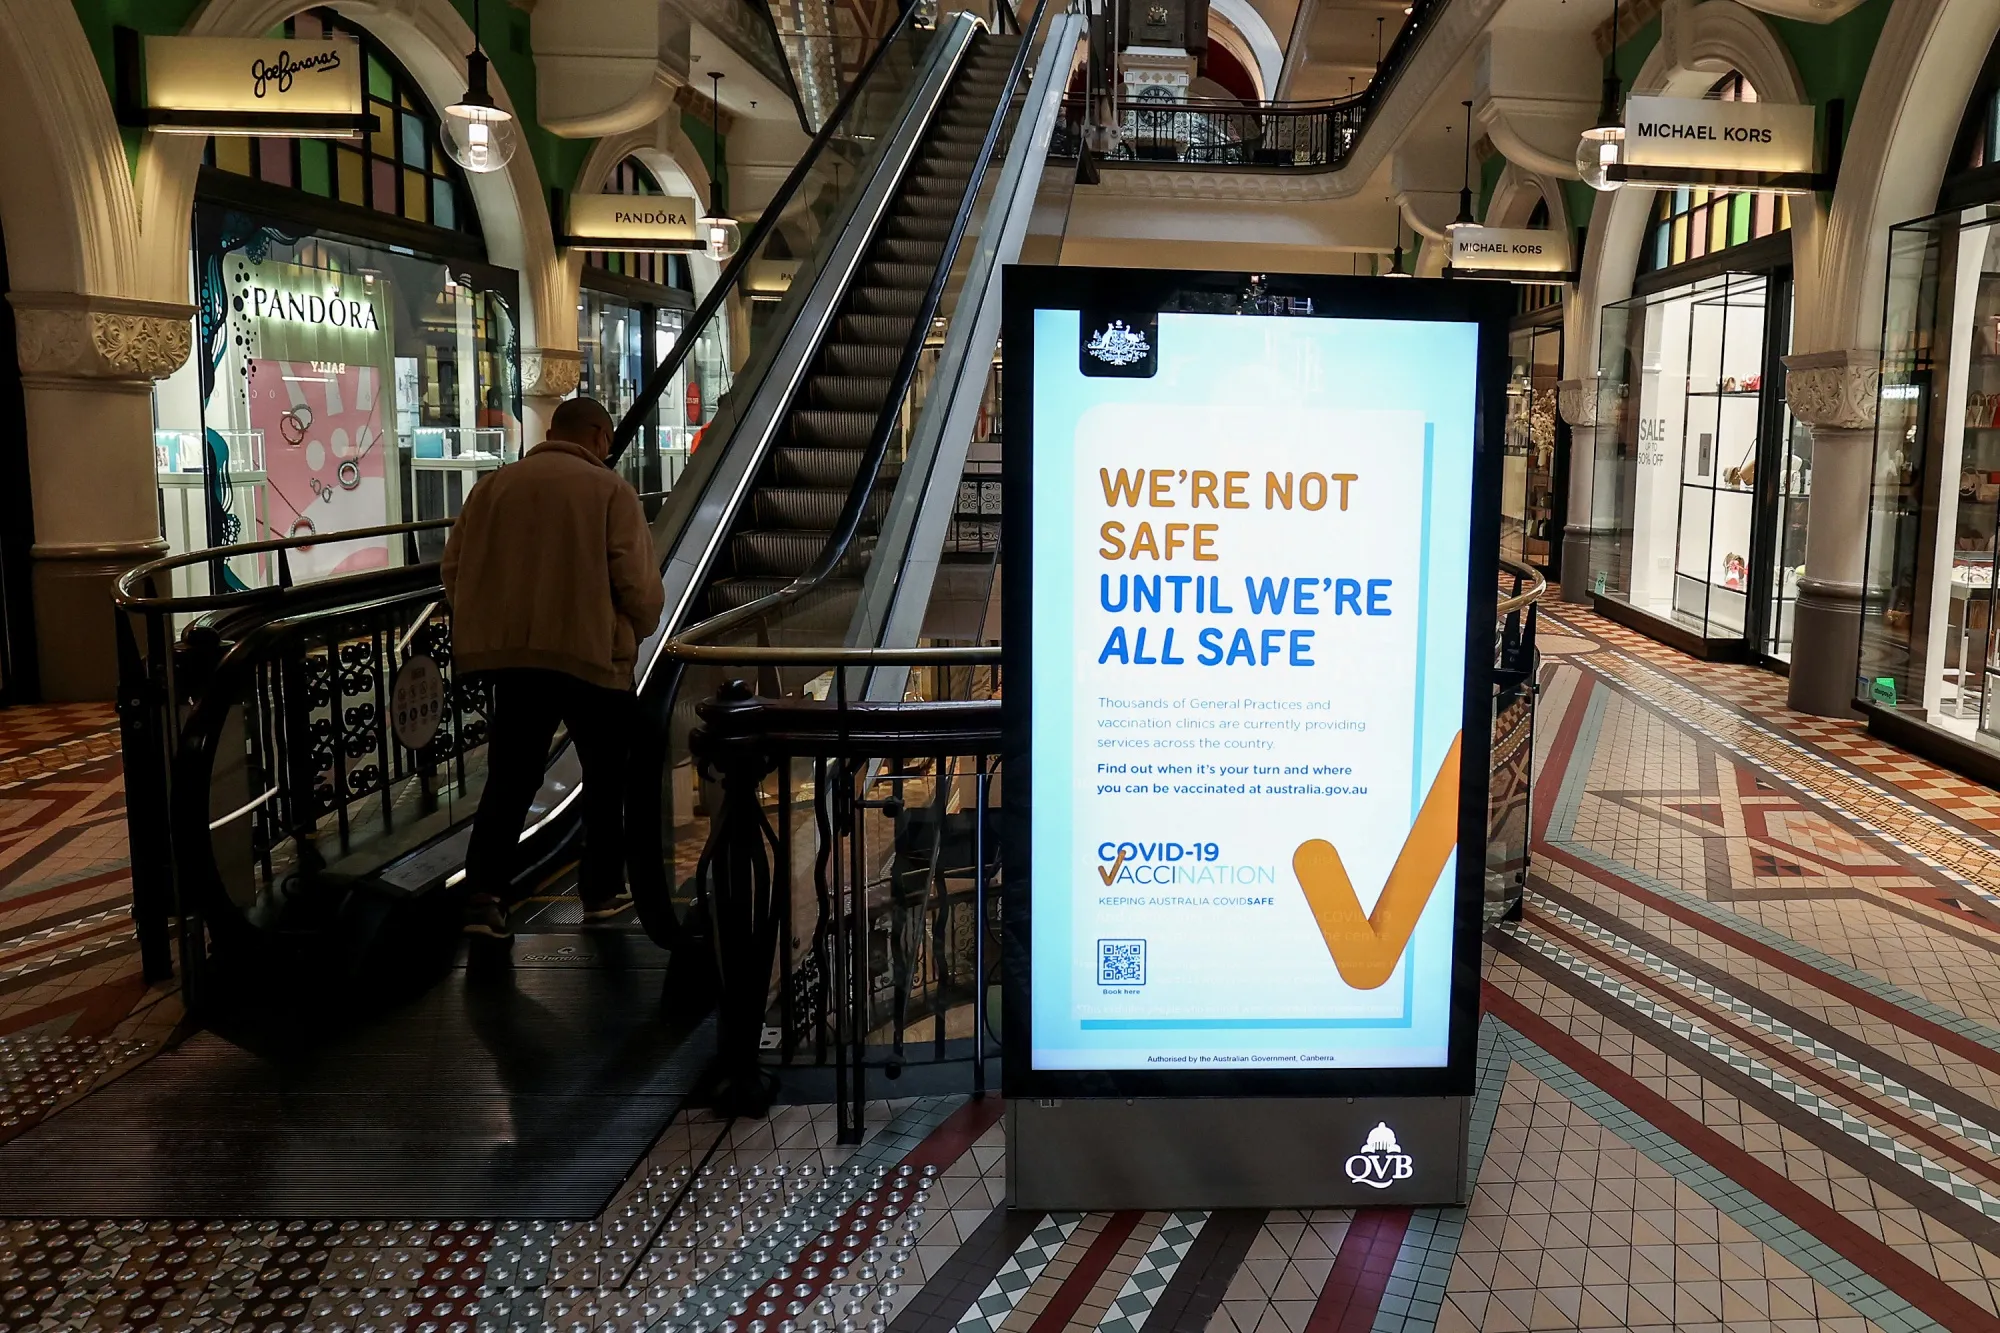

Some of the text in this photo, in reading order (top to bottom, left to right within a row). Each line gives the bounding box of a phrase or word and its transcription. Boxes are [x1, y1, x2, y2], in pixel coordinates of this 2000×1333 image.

[1638, 123, 1773, 144] MICHAEL KORS
[615, 209, 687, 225] PANDORA
[1459, 242, 1543, 254] MICHAEL KORS
[254, 286, 380, 331] PANDORA
[1640, 418, 1665, 441] SALE
[1651, 443, 1658, 452] TO
[1652, 453, 1663, 466] OFF
[1099, 467, 1359, 512] WE’RE NOT
[1099, 520, 1220, 562] SAFE
[1100, 573, 1393, 617] UNTIL WE’RE
[1097, 625, 1316, 667] ALL SAFE
[1097, 697, 1331, 710] Thousands of General Practices and
[1097, 718, 1366, 733] vaccination clinics are currently providing
[1097, 737, 1275, 751] services across the country.
[1097, 763, 1352, 777] Find out when it’s your turn and where
[1096, 783, 1368, 797] you can be vaccinated at australia.gov.au
[1097, 841, 1220, 863] COVID-19
[1098, 896, 1275, 906] KEEPING AUSTRALIA COVIDSAFE
[1147, 1055, 1187, 1063] Authorised
[1188, 1055, 1198, 1064] by
[1199, 1055, 1212, 1063] the
[1212, 1055, 1250, 1063] Australian
[1250, 1054, 1298, 1064] Government,
[1345, 1155, 1413, 1189] QVB
